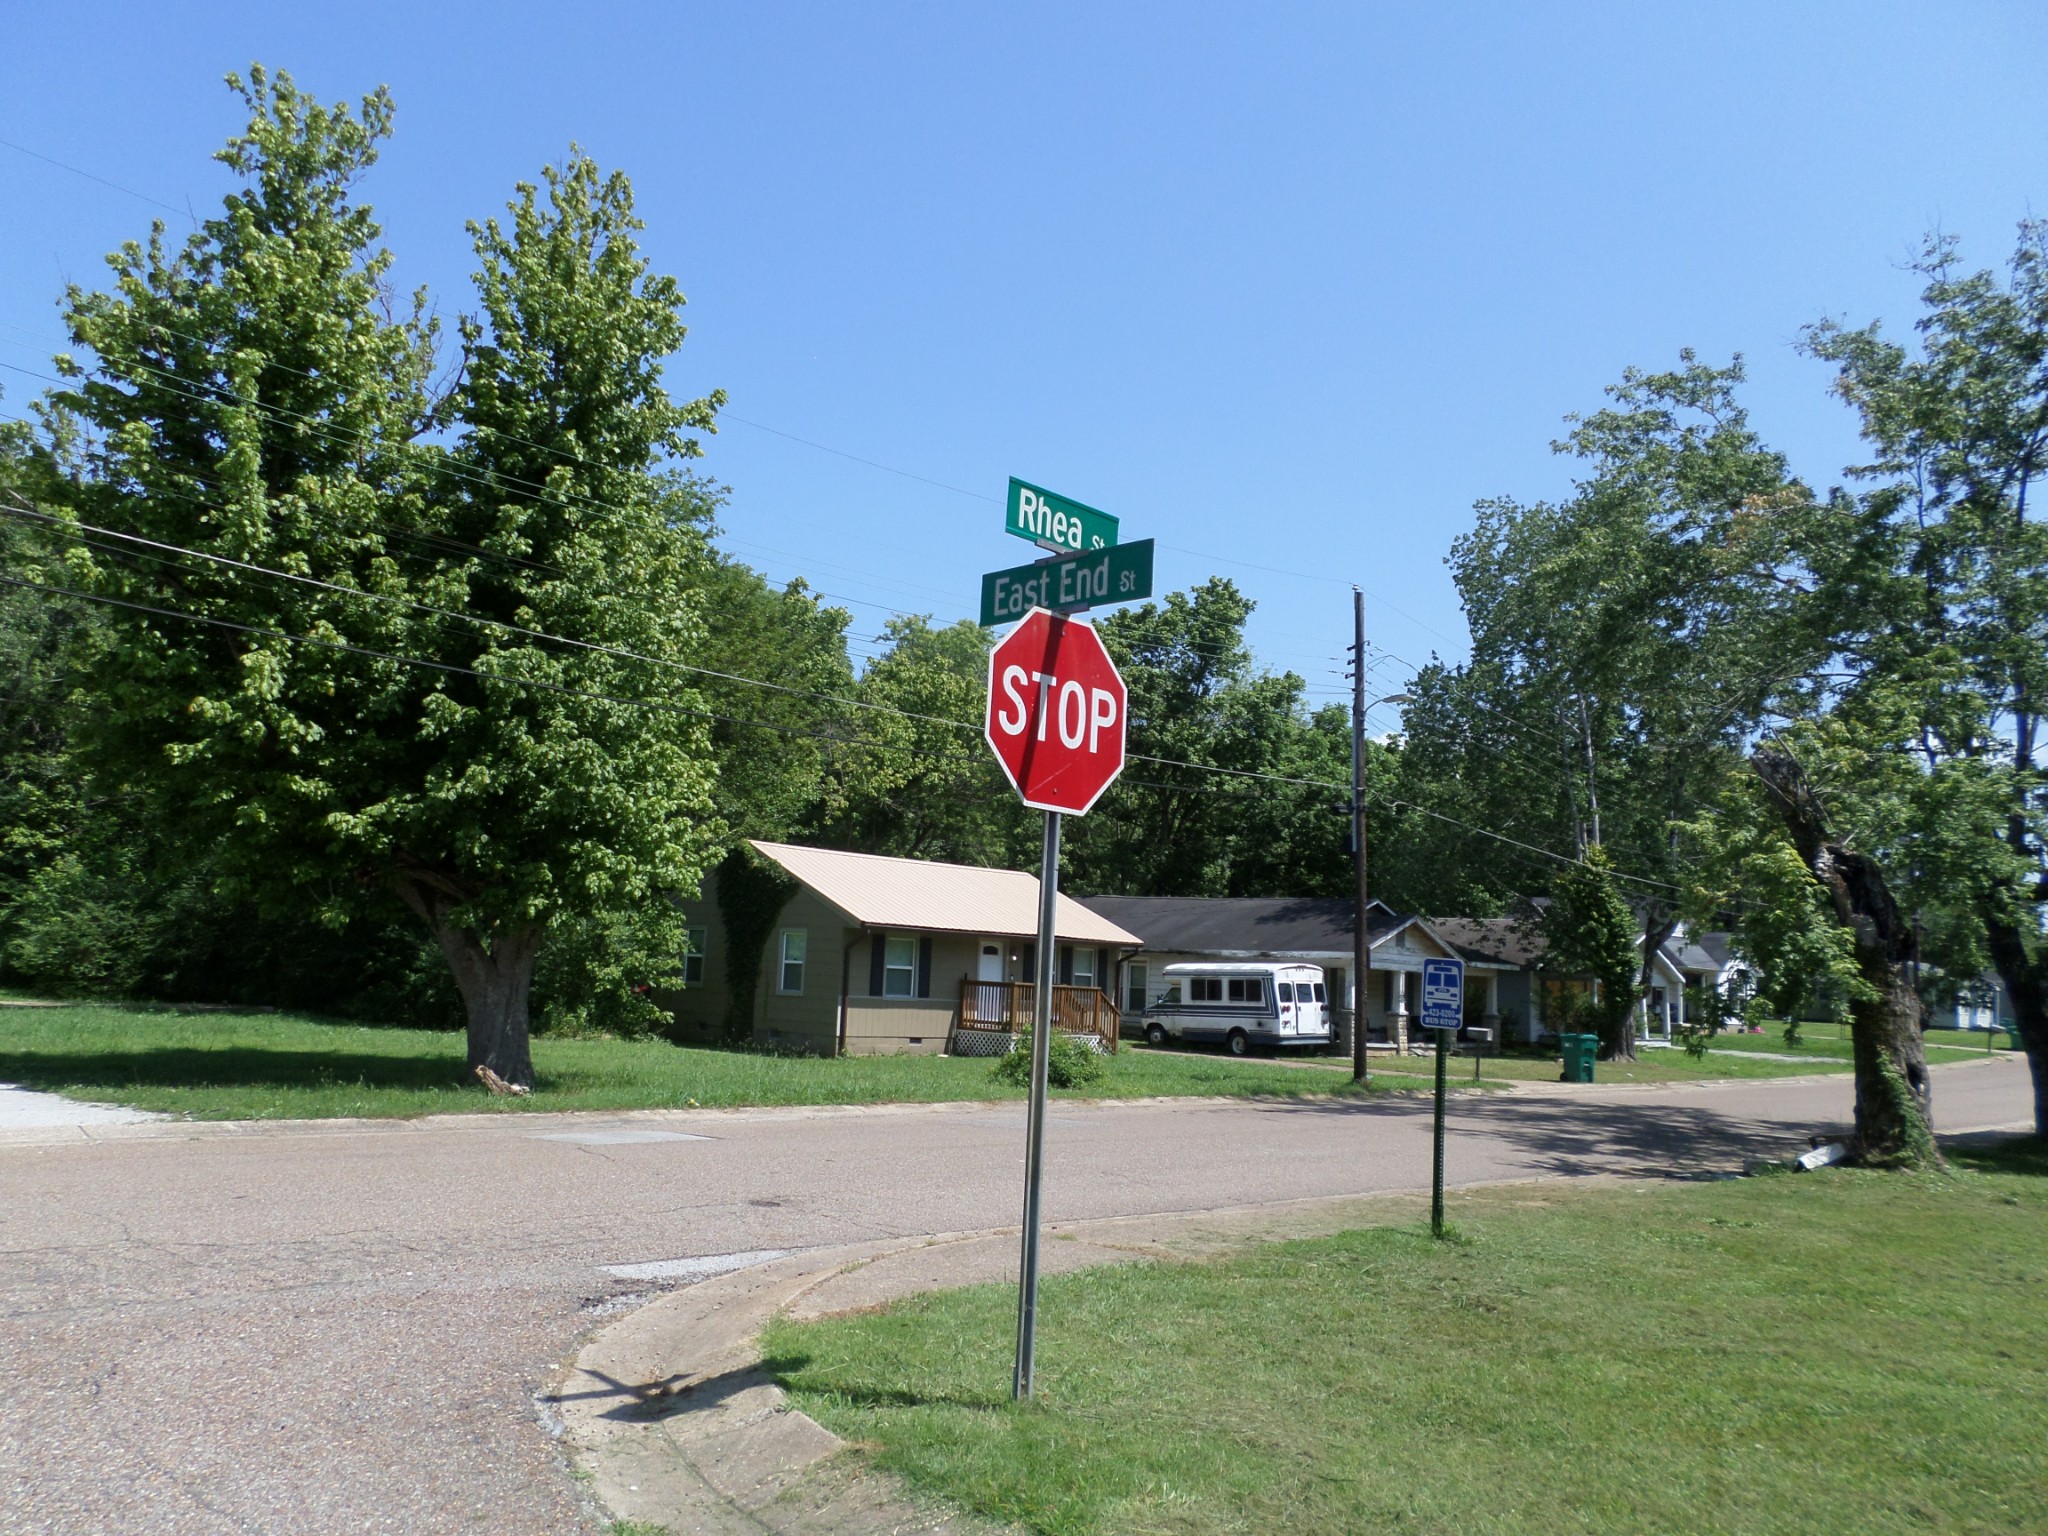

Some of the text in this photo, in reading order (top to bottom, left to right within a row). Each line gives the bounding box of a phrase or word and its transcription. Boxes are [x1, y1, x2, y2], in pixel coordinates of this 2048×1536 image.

[1017, 487, 1083, 549] Rhea
[993, 556, 1136, 617] East End St
[998, 664, 1117, 754] STOP
[1440, 1018, 1458, 1026] STOP
